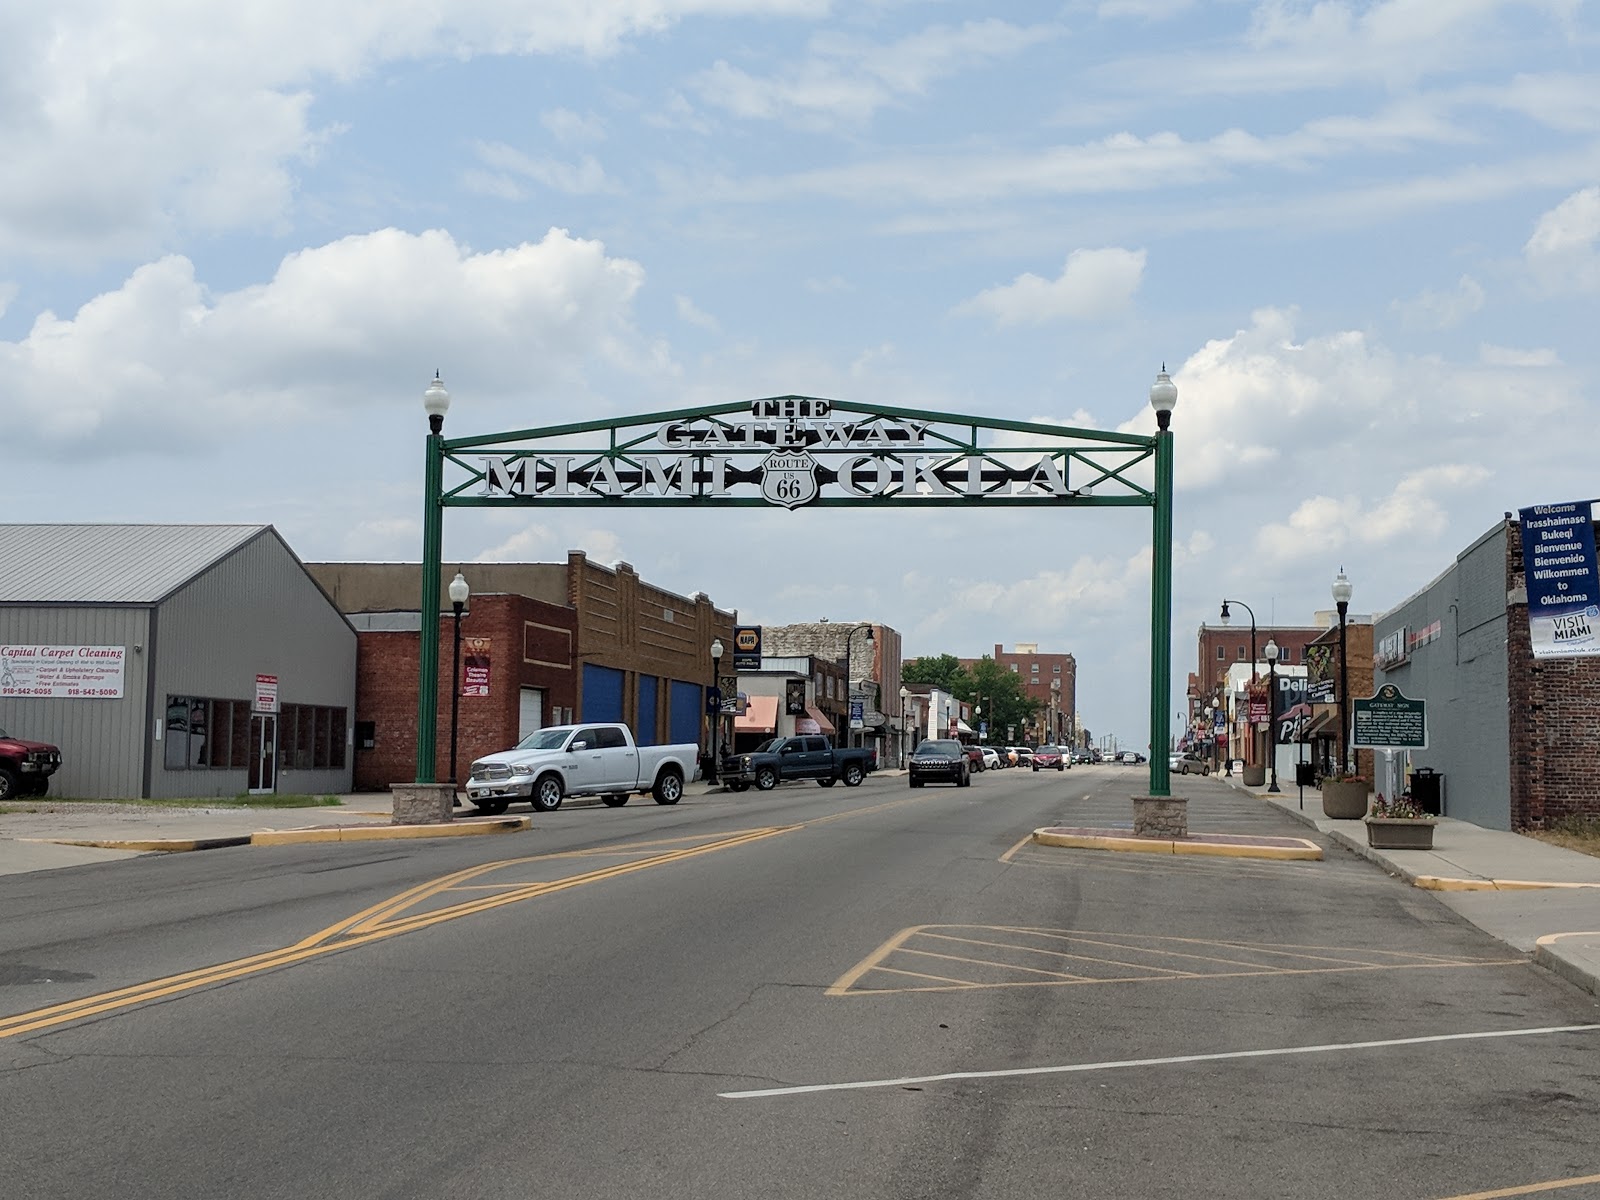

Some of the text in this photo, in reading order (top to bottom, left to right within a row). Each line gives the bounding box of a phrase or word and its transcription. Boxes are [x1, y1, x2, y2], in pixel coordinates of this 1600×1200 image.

[751, 399, 832, 420] THE
[656, 421, 935, 448] GATEWAY
[770, 459, 809, 468] ROUTE
[477, 455, 1093, 496] MIAMI OKLA.
[783, 472, 795, 480] US
[776, 479, 801, 499] 66
[1534, 504, 1576, 515] Welcome
[1526, 516, 1586, 529] Irasshaimase
[1541, 528, 1573, 540] Bukeqi
[1534, 542, 1582, 554] Bienvenue
[1534, 554, 1585, 567] Bienvenido
[1533, 568, 1589, 580] Wilkommen
[1557, 582, 1568, 590] to
[1540, 594, 1588, 605] Oklahoma
[1553, 614, 1586, 630] VISIT
[1554, 625, 1592, 640] MIAMI
[1, 646, 123, 659] Capital Carpet Cleaning
[1280, 678, 1307, 691] Deli
